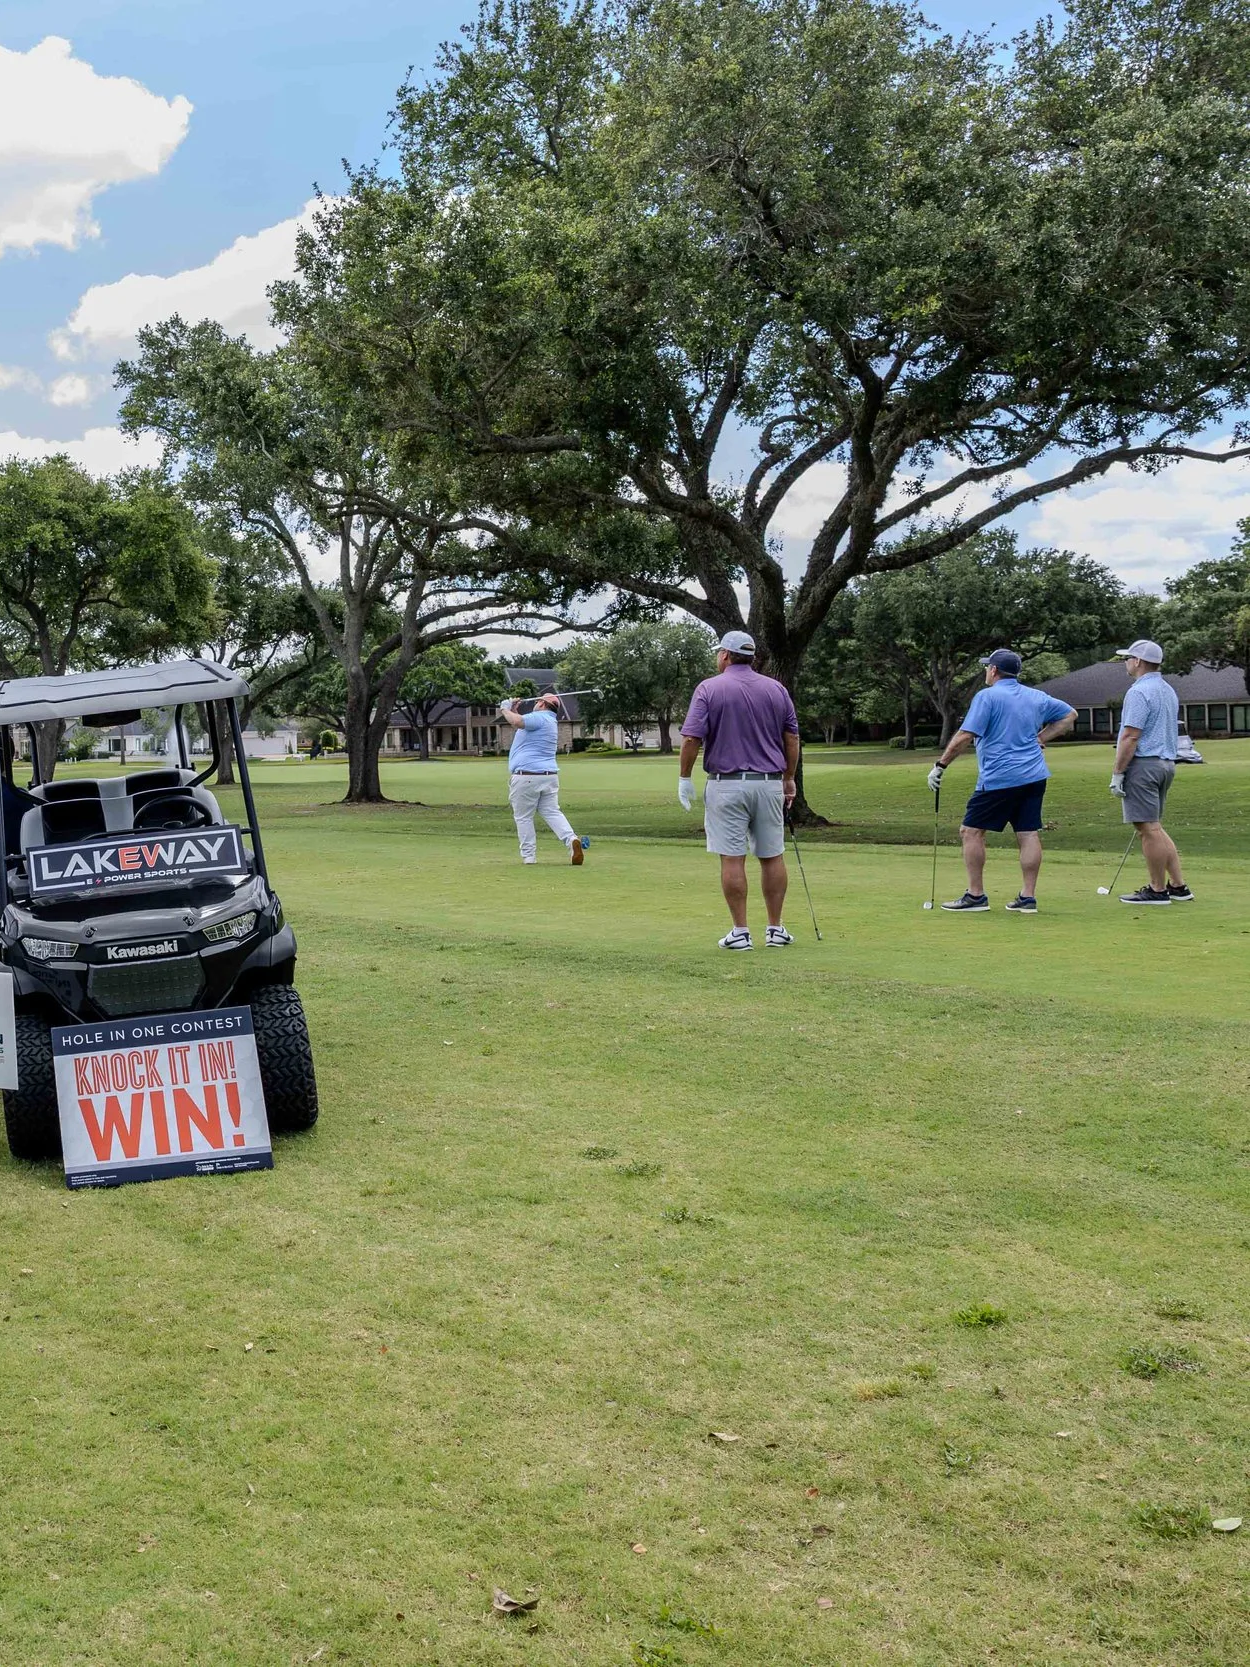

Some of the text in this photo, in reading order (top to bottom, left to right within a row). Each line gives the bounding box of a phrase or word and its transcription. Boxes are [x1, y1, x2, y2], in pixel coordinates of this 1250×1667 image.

[41, 836, 226, 880] LAKEWAY
[104, 872, 142, 883] POWER
[144, 867, 187, 878] SPORTS
[107, 940, 178, 960] Kawasaki
[62, 1016, 243, 1047] HOLE IN ONE CONTEST
[74, 1040, 237, 1096] KNOCK IT IN!
[78, 1082, 245, 1162] WIN!
